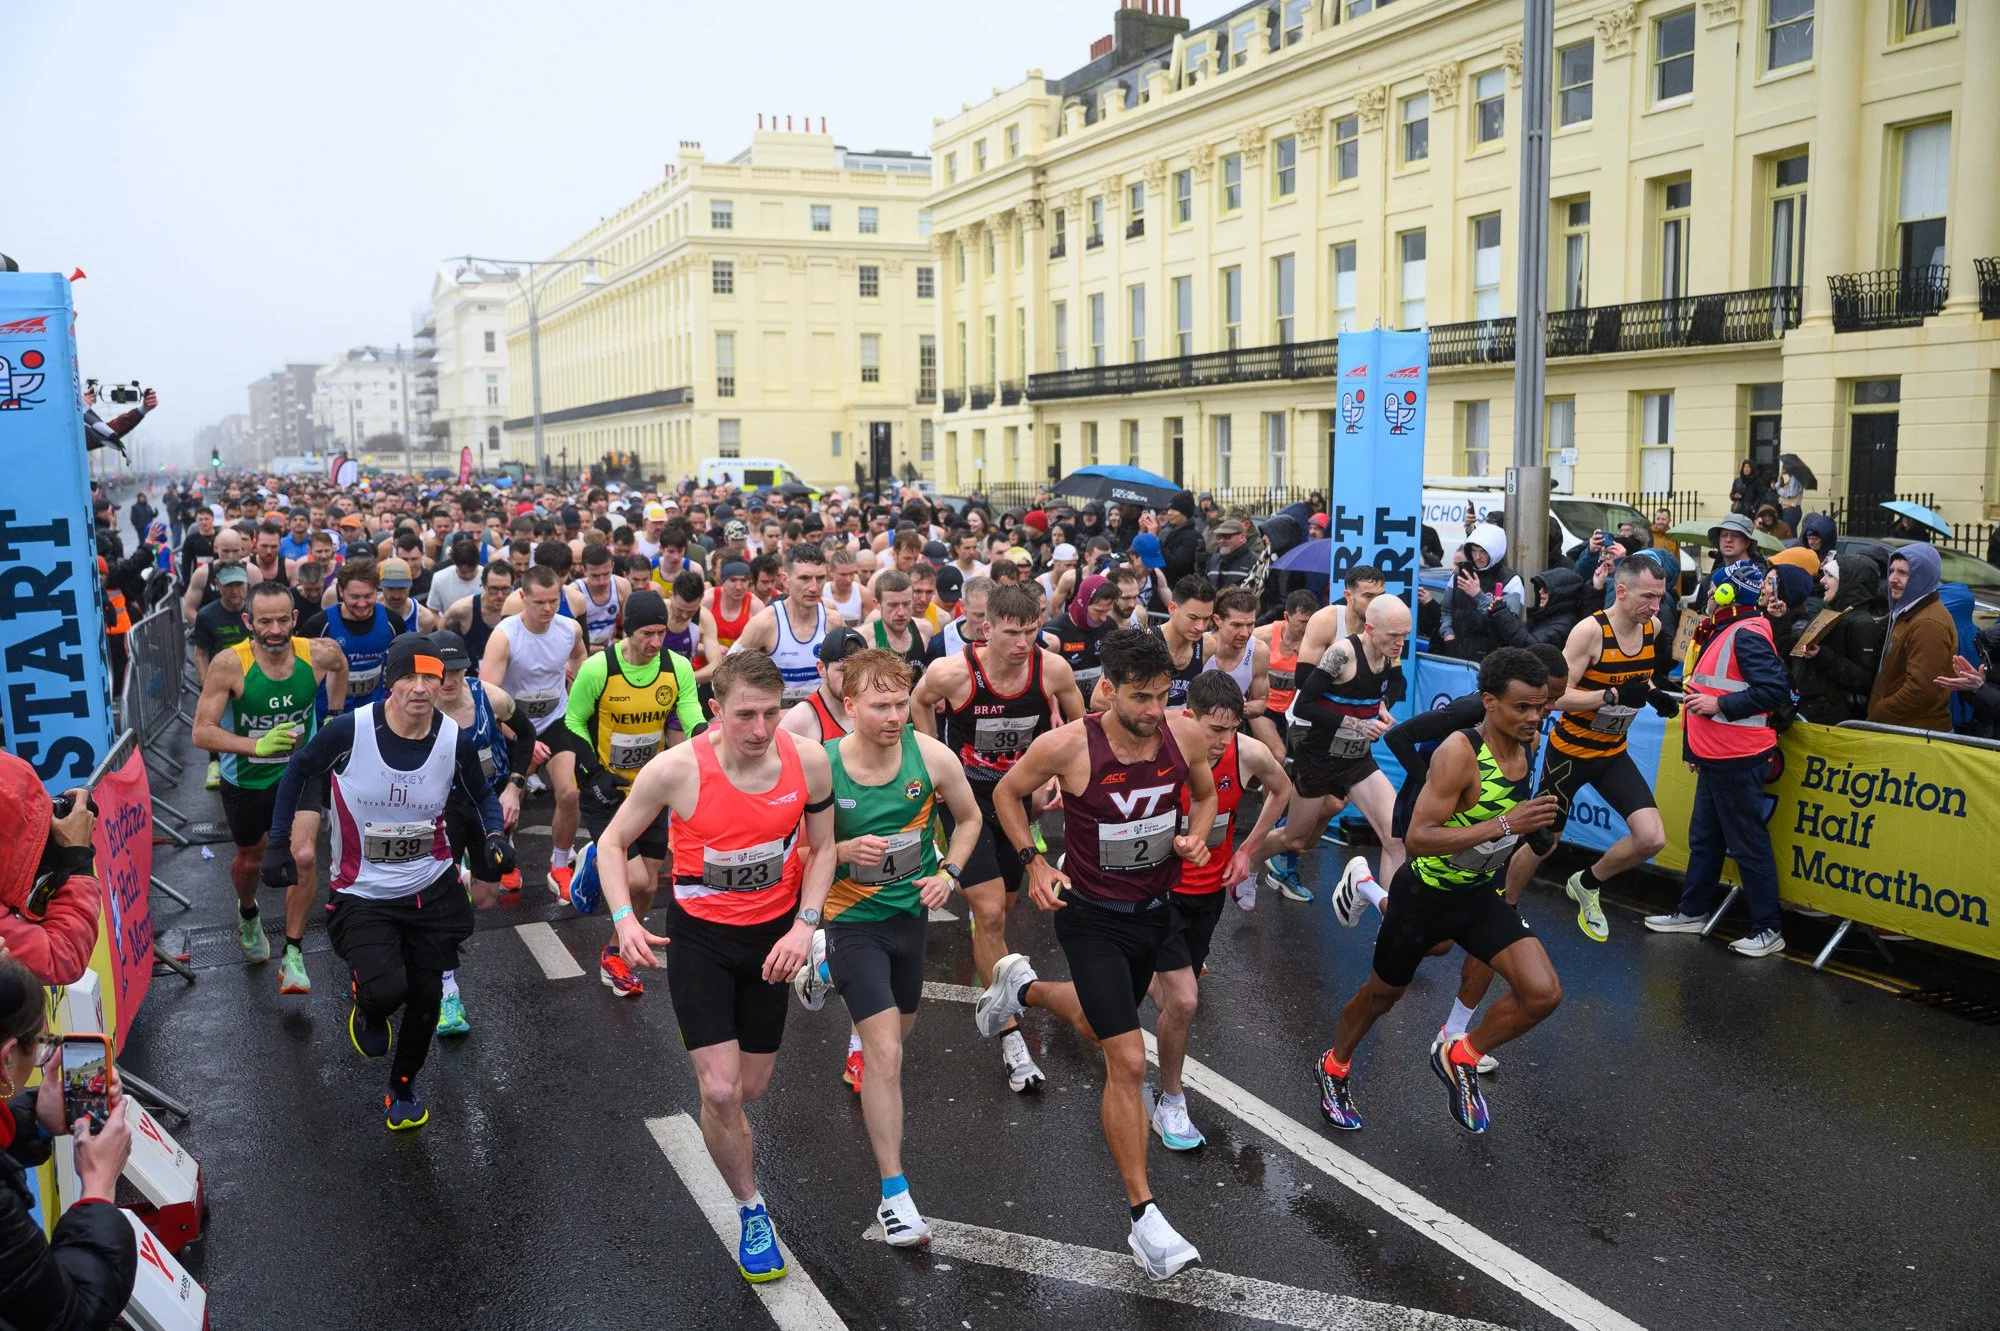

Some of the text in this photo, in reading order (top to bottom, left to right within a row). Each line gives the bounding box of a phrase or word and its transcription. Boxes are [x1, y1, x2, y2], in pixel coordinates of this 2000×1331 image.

[974, 670, 986, 689] soar
[528, 701, 547, 714] 52
[974, 705, 1005, 715] BRAT
[1606, 716, 1627, 731] 21
[994, 731, 1019, 748] 39
[1342, 740, 1365, 754] 154
[621, 746, 652, 765] 239
[389, 783, 408, 806] hj
[1801, 755, 1967, 818] Brighton
[1109, 783, 1176, 819] VT
[1794, 800, 1876, 849] Half
[381, 838, 421, 858] 139
[1133, 839, 1149, 862] 2
[721, 863, 769, 886] 123
[882, 854, 897, 876] 4
[1791, 844, 1990, 927] Marathon
